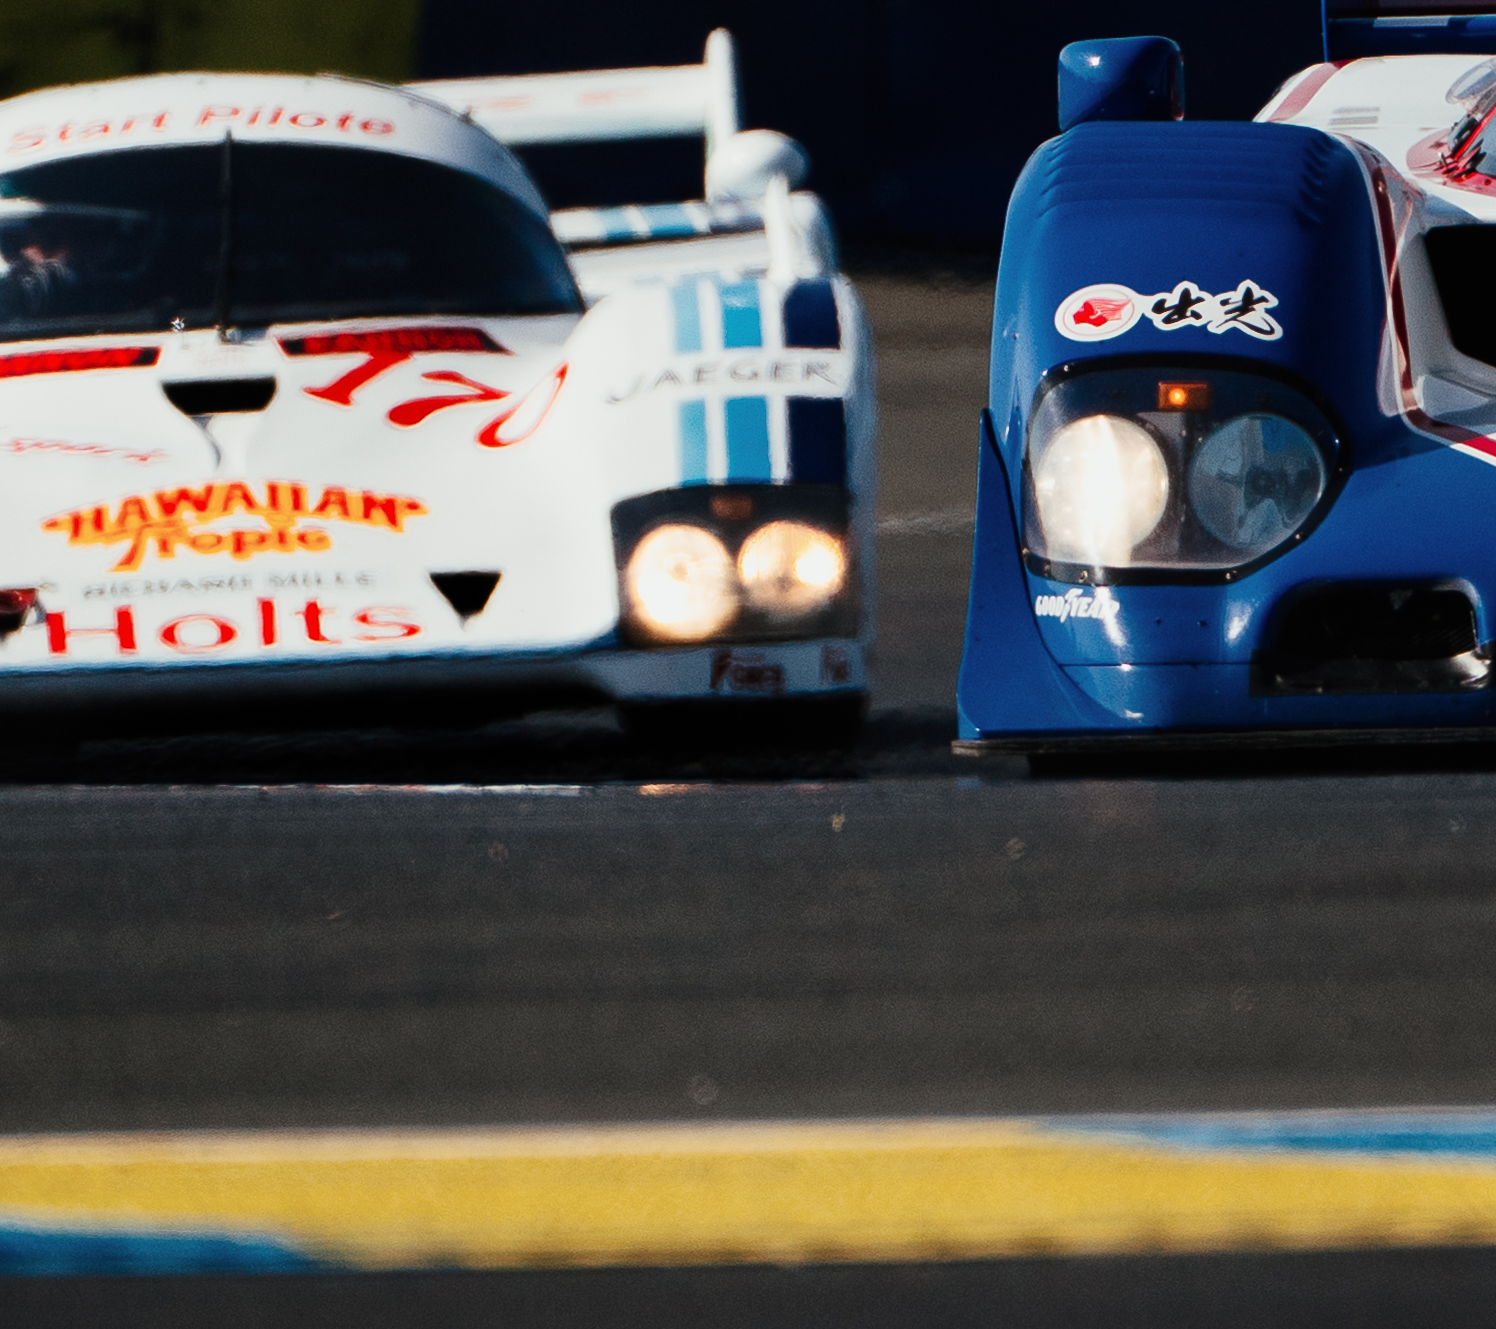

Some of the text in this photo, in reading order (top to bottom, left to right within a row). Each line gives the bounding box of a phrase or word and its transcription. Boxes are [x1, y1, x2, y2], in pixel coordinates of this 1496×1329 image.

[10, 104, 396, 152] Start Pilote
[1151, 286, 1276, 337] 出光
[604, 358, 840, 405] JAEGER
[60, 480, 410, 546] HAWAIIAN
[45, 597, 422, 656] Holts
